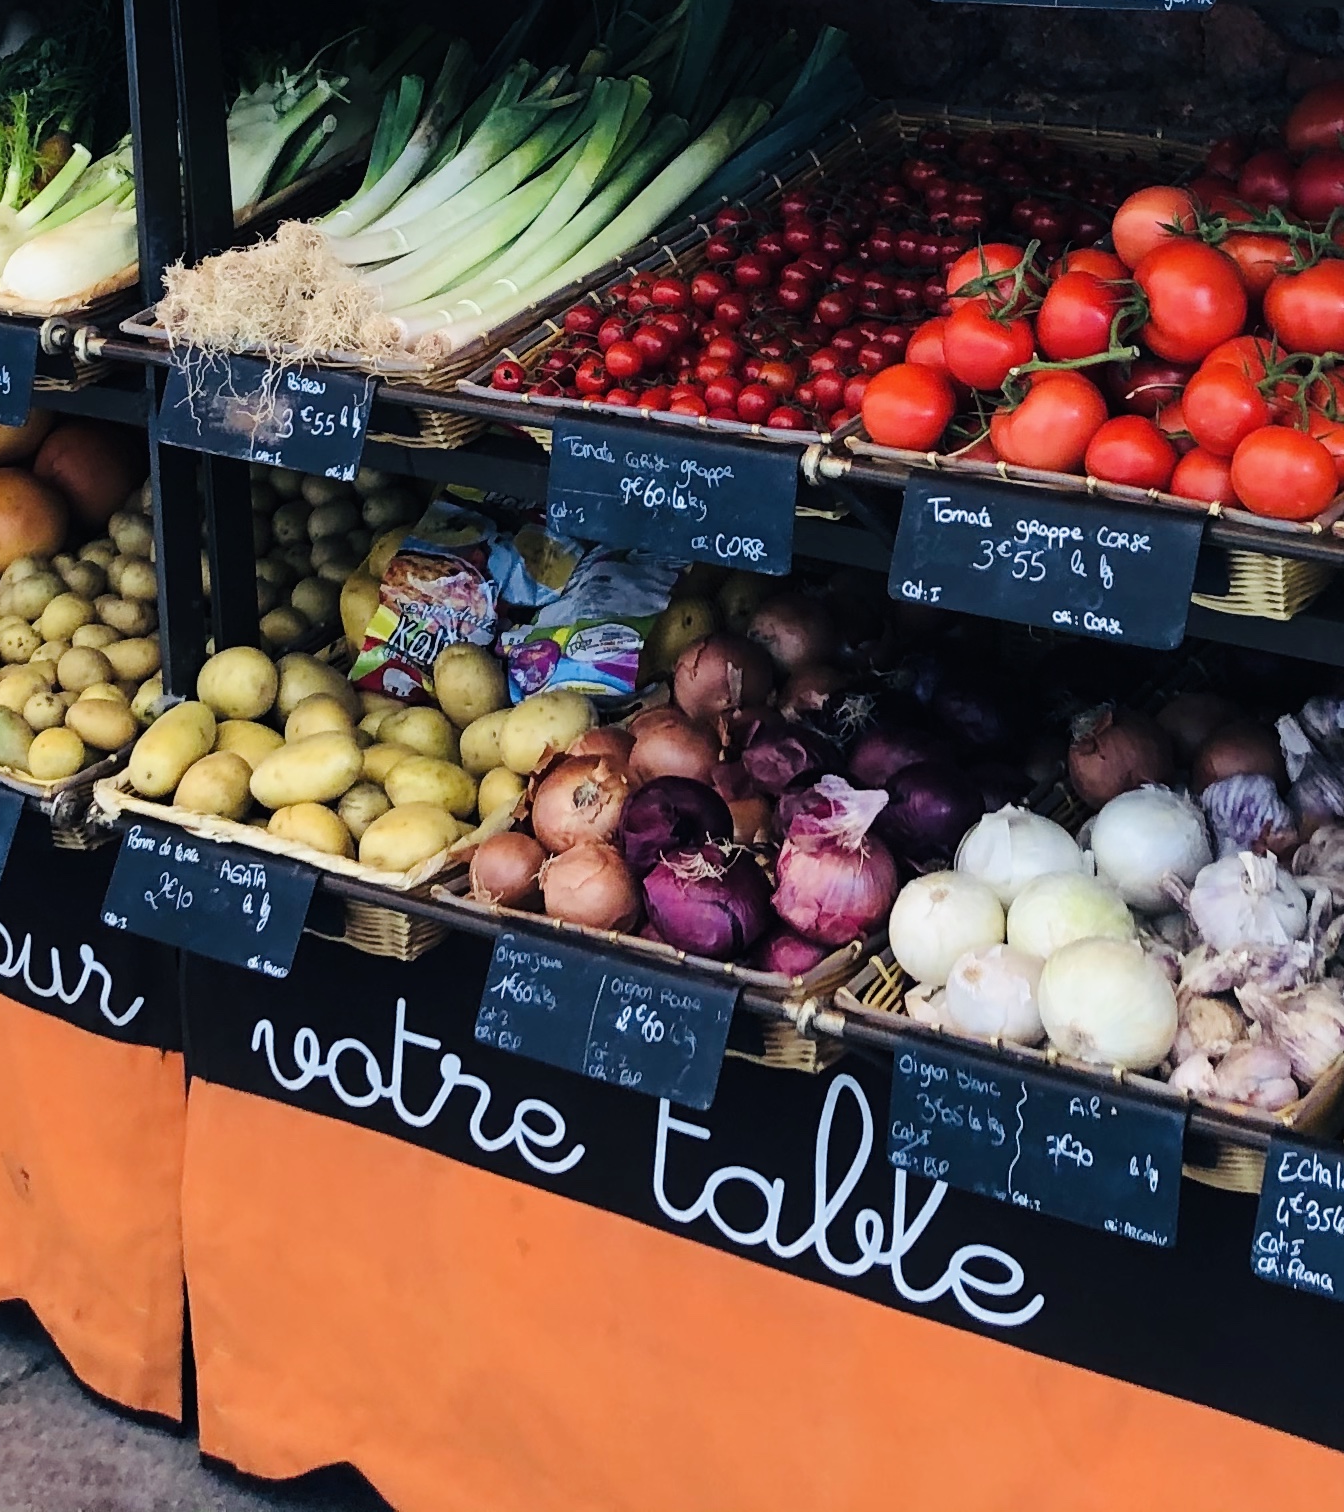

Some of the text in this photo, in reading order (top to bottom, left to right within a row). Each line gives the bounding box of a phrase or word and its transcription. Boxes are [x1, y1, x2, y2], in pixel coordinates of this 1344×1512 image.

[562, 436, 734, 488] Tomate grappe
[927, 496, 993, 527] Tomate
[1013, 519, 1084, 549] grappe
[972, 539, 1047, 582] 3€55
[1071, 549, 1088, 578] le
[219, 859, 268, 890] AGATA
[898, 1053, 950, 1088] Oignon
[251, 997, 1045, 1326] votre table
